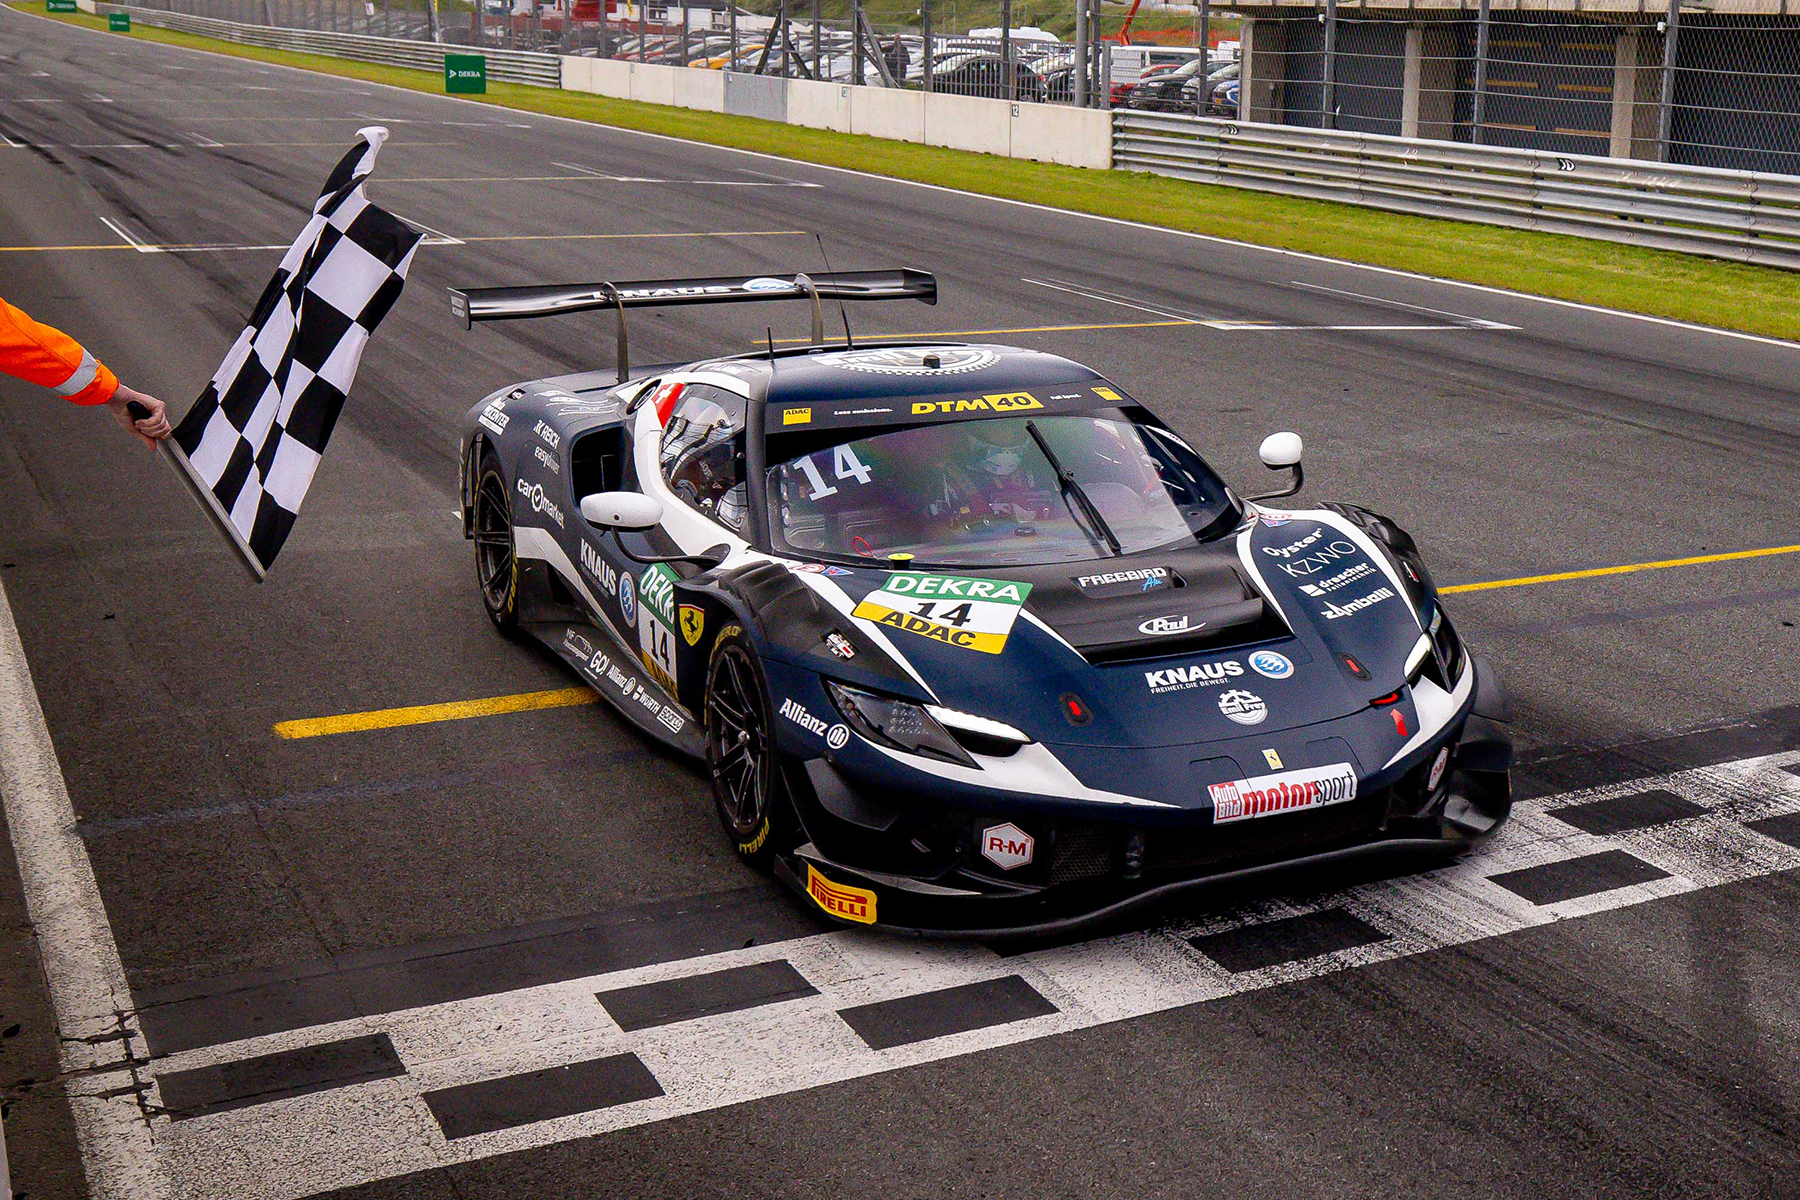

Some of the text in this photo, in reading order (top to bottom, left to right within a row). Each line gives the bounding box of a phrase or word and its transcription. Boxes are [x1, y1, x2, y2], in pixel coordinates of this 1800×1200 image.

[458, 70, 481, 78] DEKRA
[1012, 105, 1019, 116] 12
[785, 408, 810, 416] ADAC
[911, 396, 1032, 415] DTM 40
[792, 443, 872, 501] 14
[1262, 528, 1323, 558] Oyster
[580, 537, 617, 596] KNAUS
[1277, 541, 1357, 578] KZWO
[1077, 567, 1168, 588] FREEBIRD
[1319, 562, 1371, 588] drescher
[886, 576, 1021, 601] DEKRA
[909, 602, 973, 627] 14
[1151, 615, 1189, 633] Paul
[879, 611, 977, 647] ADAC
[649, 619, 670, 673] 14
[590, 650, 610, 676] GO!
[1145, 660, 1245, 689] KNAUS
[606, 664, 628, 688] Allianz
[778, 697, 829, 737] Allianz
[1220, 701, 1266, 715] Emil Frey
[1213, 784, 1240, 803] Auto
[1217, 800, 1241, 819] Bild
[738, 816, 770, 855] PIRELLI
[988, 836, 1027, 857] R-M
[811, 874, 868, 918] PIRELLI
